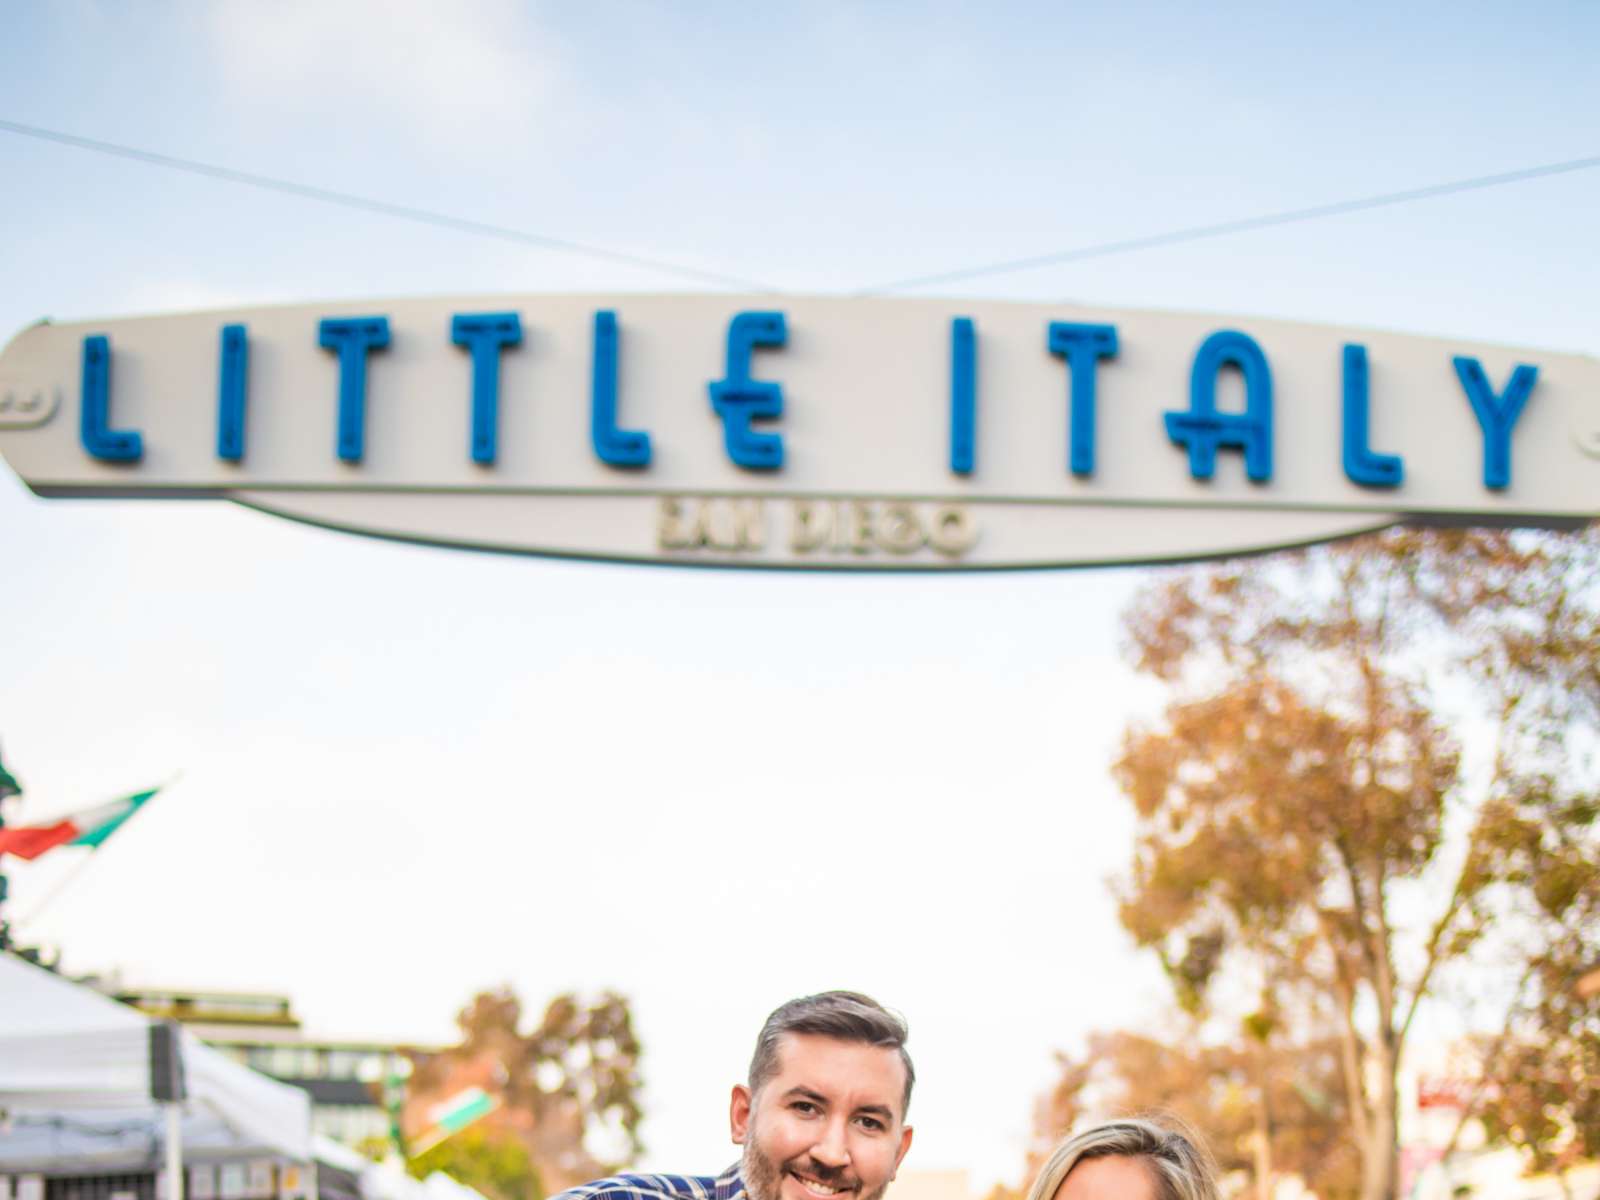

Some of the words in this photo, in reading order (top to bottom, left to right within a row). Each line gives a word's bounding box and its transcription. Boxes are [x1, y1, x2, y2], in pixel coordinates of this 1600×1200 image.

[80, 310, 790, 468] LITTLE
[948, 316, 1540, 489] ITALY
[657, 497, 763, 552] SAN
[790, 498, 978, 556] DIEGO
